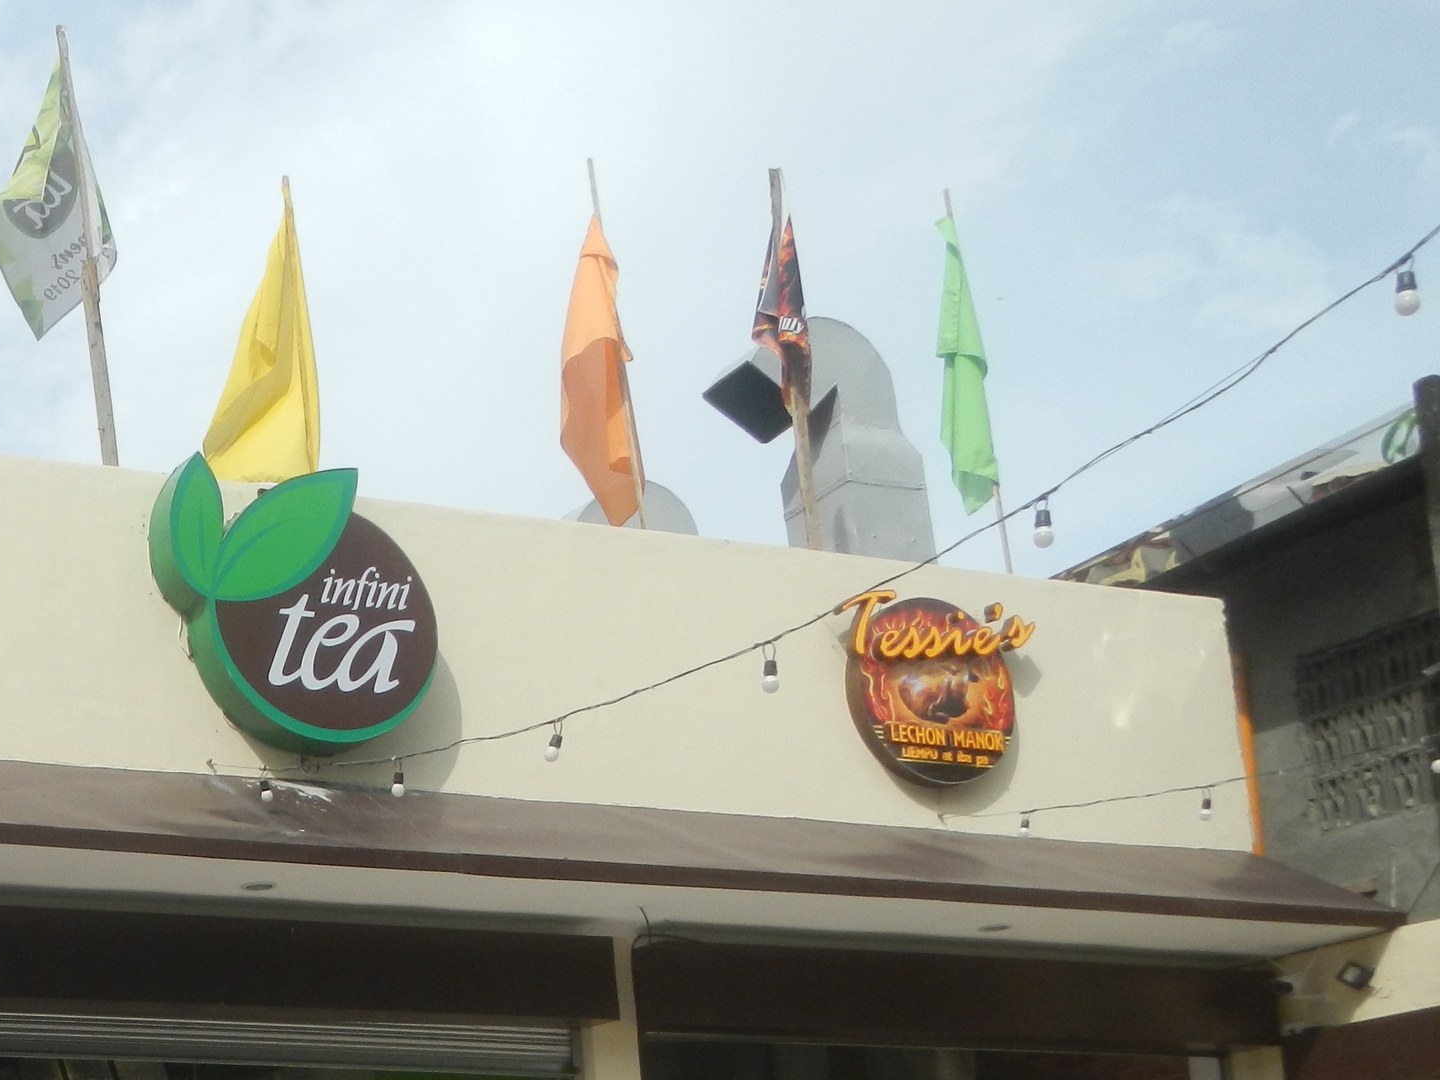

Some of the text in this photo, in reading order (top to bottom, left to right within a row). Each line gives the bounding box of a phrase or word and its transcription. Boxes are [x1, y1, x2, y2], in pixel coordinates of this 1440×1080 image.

[320, 567, 415, 611] infini
[267, 594, 416, 694] tea
[837, 589, 1036, 659] Tessie's
[890, 722, 1005, 751] LECHON MANOK
